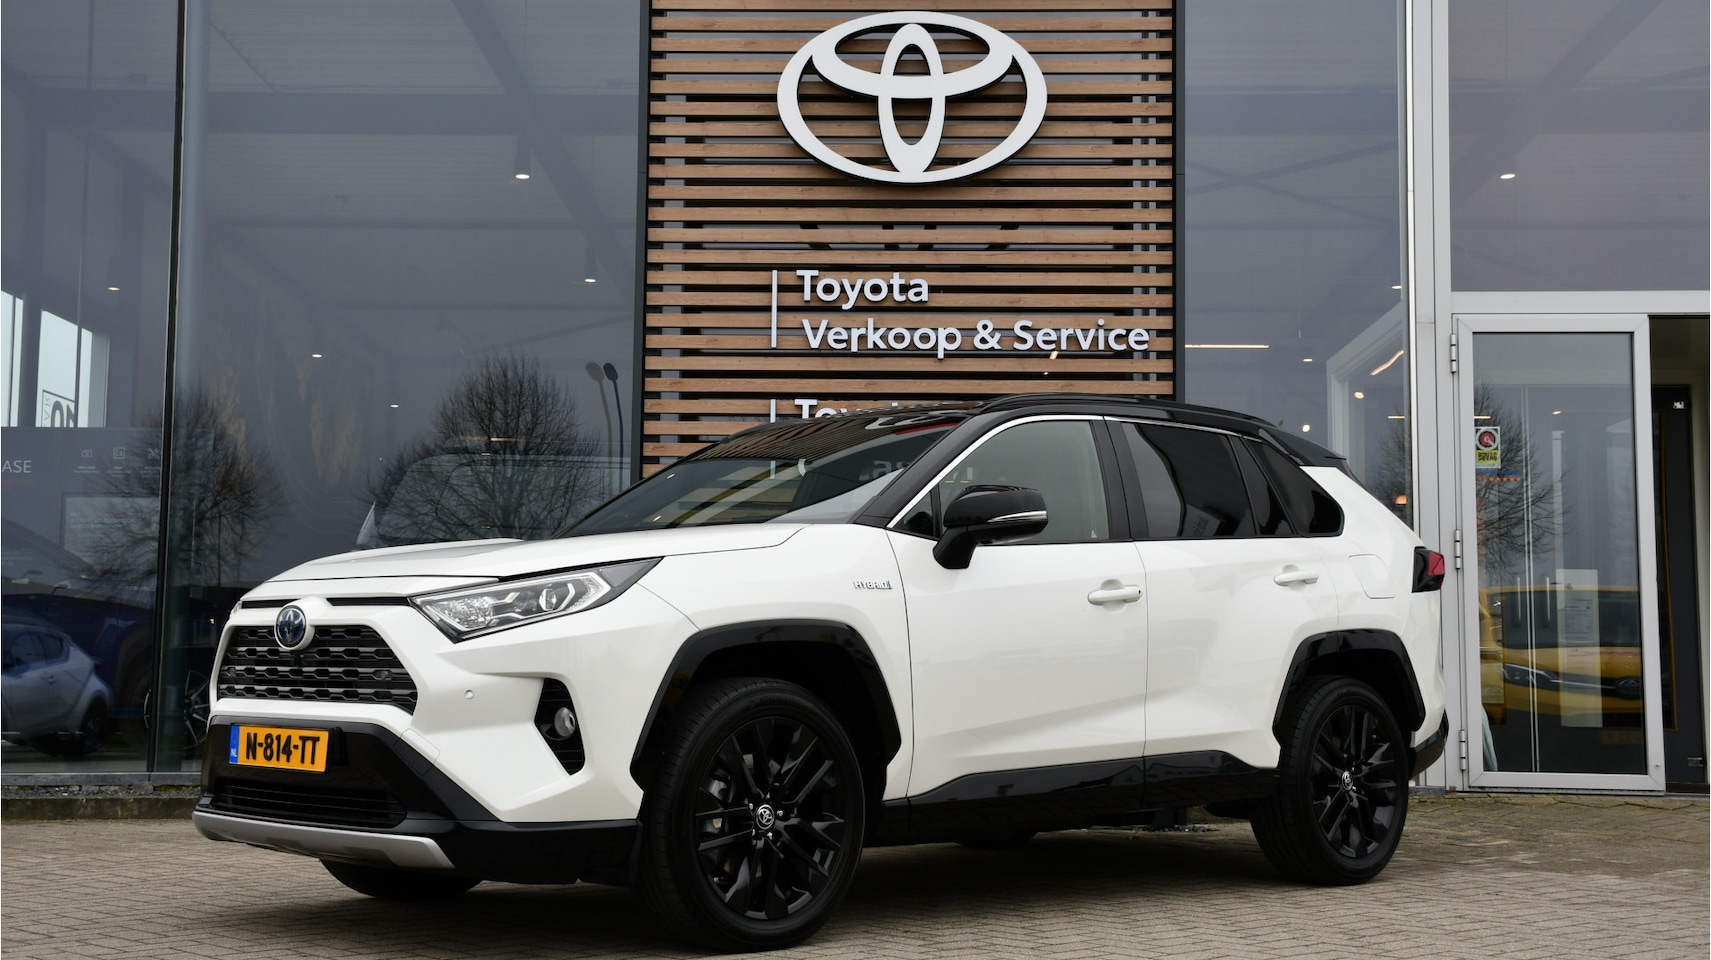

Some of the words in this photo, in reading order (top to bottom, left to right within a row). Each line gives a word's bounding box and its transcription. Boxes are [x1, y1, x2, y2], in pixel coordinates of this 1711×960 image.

[796, 269, 929, 310] Toyota
[802, 318, 962, 359] Verkoop
[973, 319, 1003, 351] &
[1013, 318, 1150, 351] Service
[246, 732, 320, 765] N-814-TT
